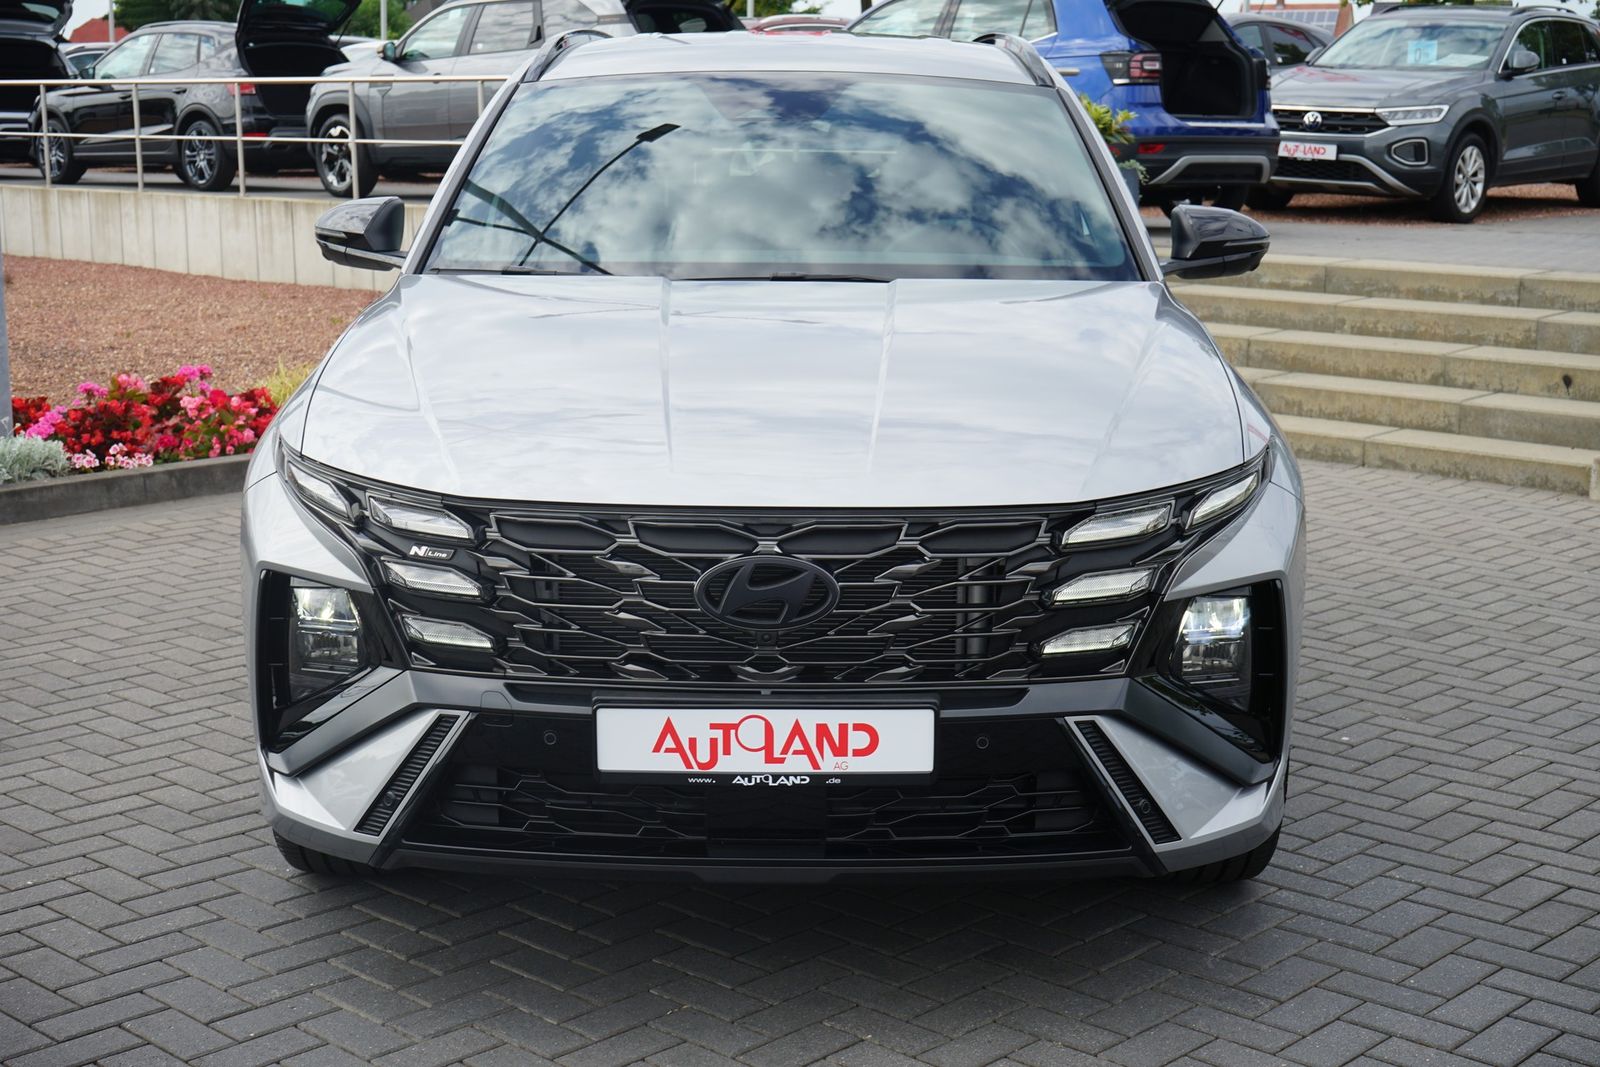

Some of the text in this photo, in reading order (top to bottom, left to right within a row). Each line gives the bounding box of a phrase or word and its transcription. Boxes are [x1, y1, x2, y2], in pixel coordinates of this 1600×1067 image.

[1282, 143, 1327, 158] AUTLAND
[652, 714, 880, 770] AUTOLAND
[833, 760, 849, 771] AG
[732, 773, 811, 786] AUTOLAND
